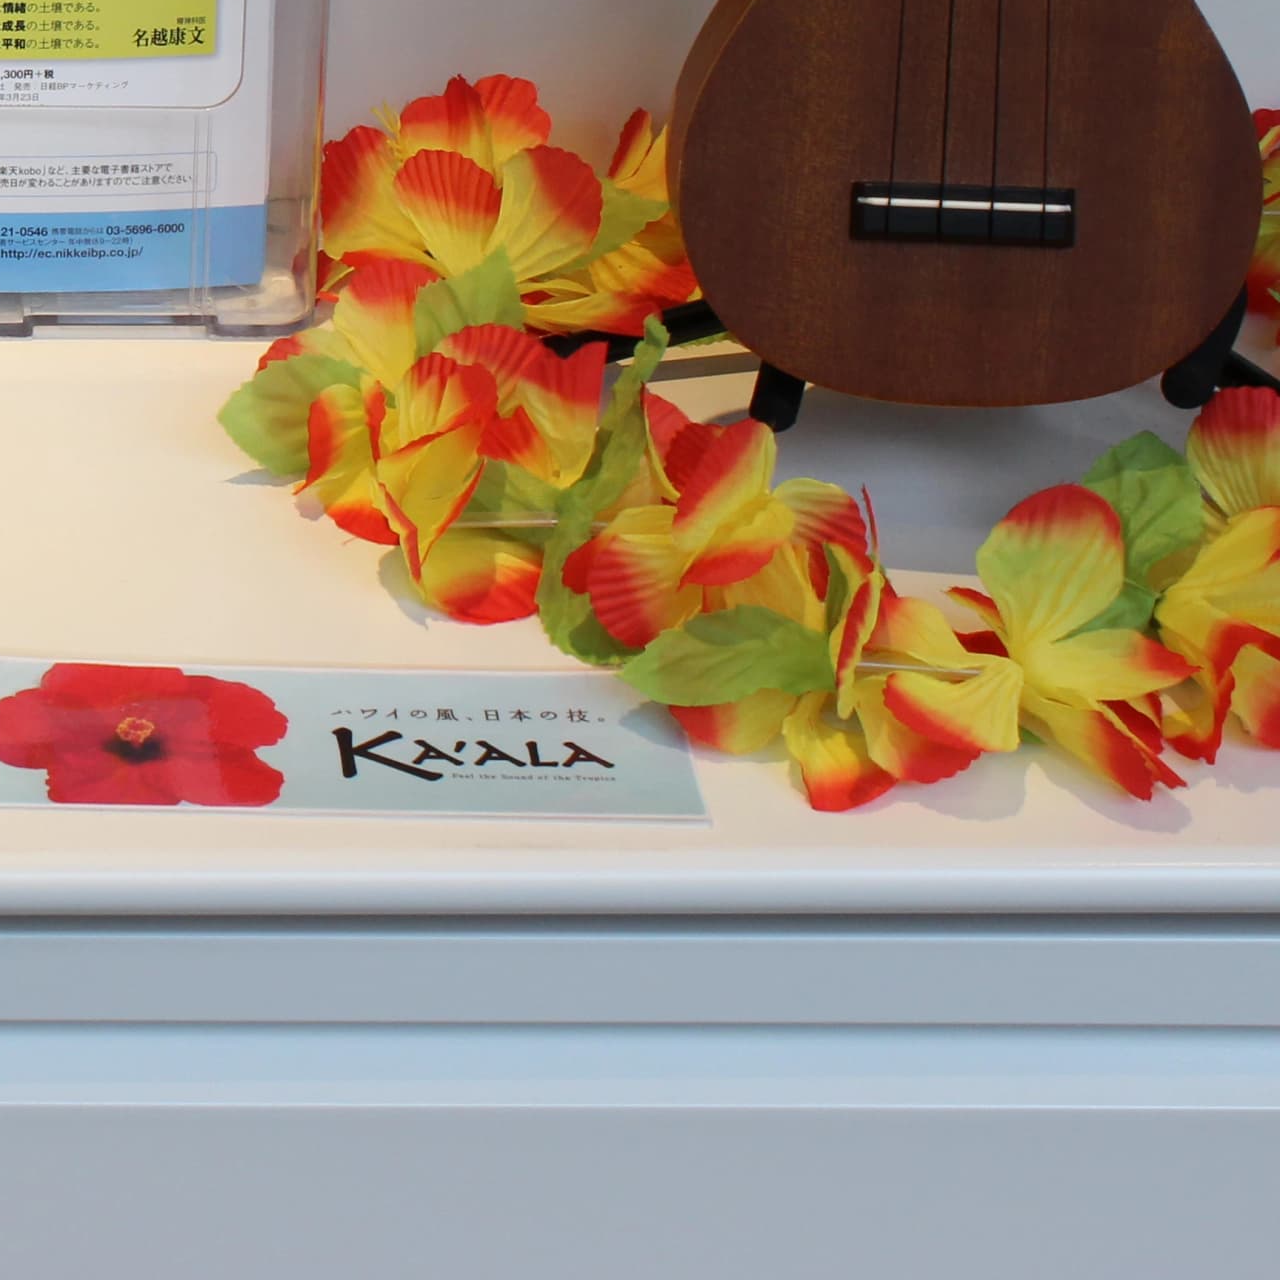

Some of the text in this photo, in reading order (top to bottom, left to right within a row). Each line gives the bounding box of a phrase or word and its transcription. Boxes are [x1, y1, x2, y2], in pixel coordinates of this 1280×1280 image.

[133, 26, 206, 48] 名越康文
[329, 708, 607, 724] ハワイの風、日本の技。
[331, 727, 616, 781] KA'ALA
